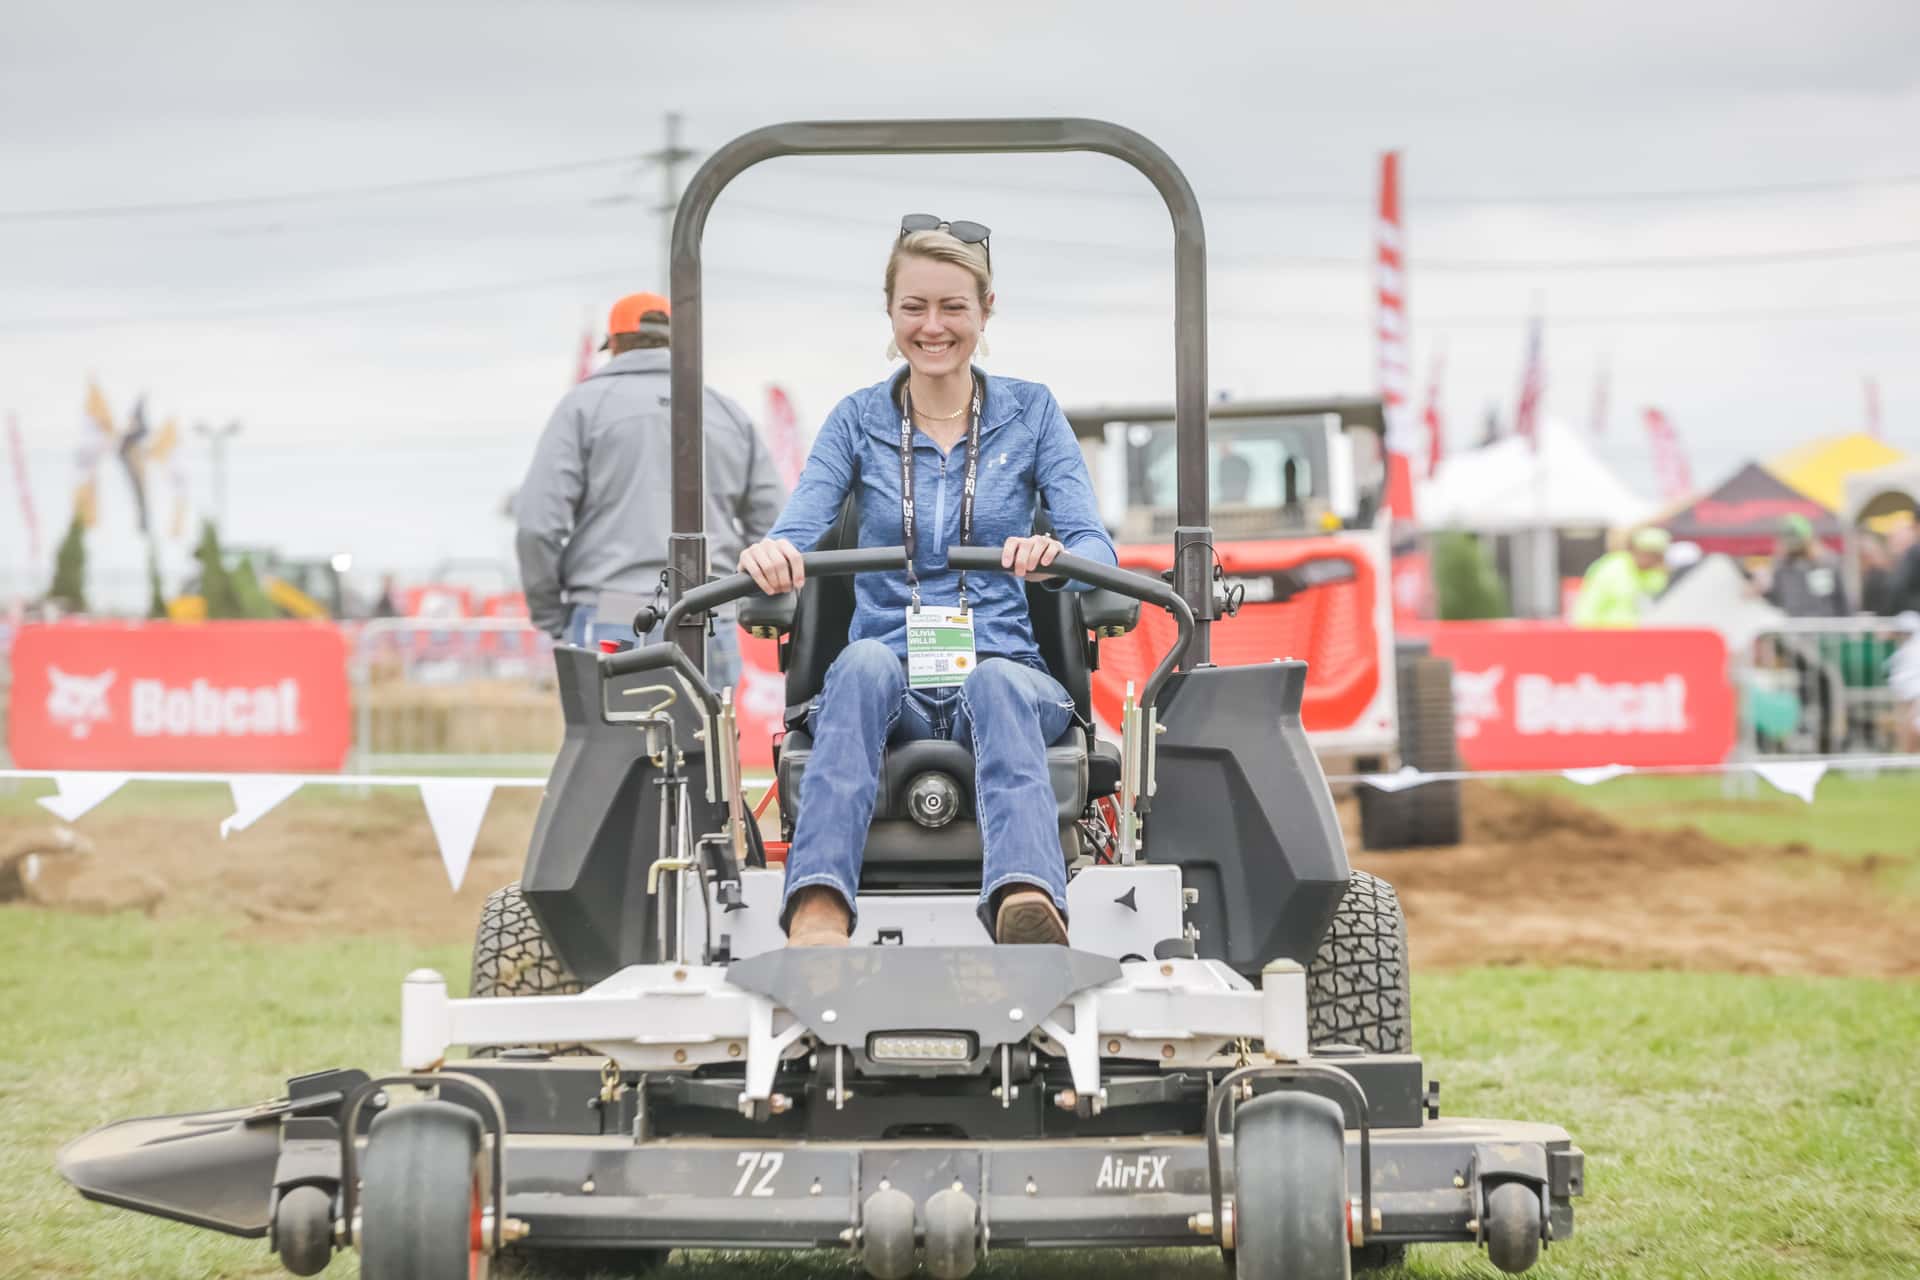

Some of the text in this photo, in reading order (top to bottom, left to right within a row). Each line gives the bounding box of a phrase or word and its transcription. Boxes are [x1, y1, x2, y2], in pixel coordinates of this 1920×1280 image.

[902, 418, 911, 434] 25
[965, 477, 975, 496] 25
[903, 499, 913, 517] 25
[132, 678, 298, 736] Bobcat
[1514, 673, 1686, 735] Bobcat
[733, 1152, 784, 1196] 72
[1096, 1155, 1168, 1188] AirFX
